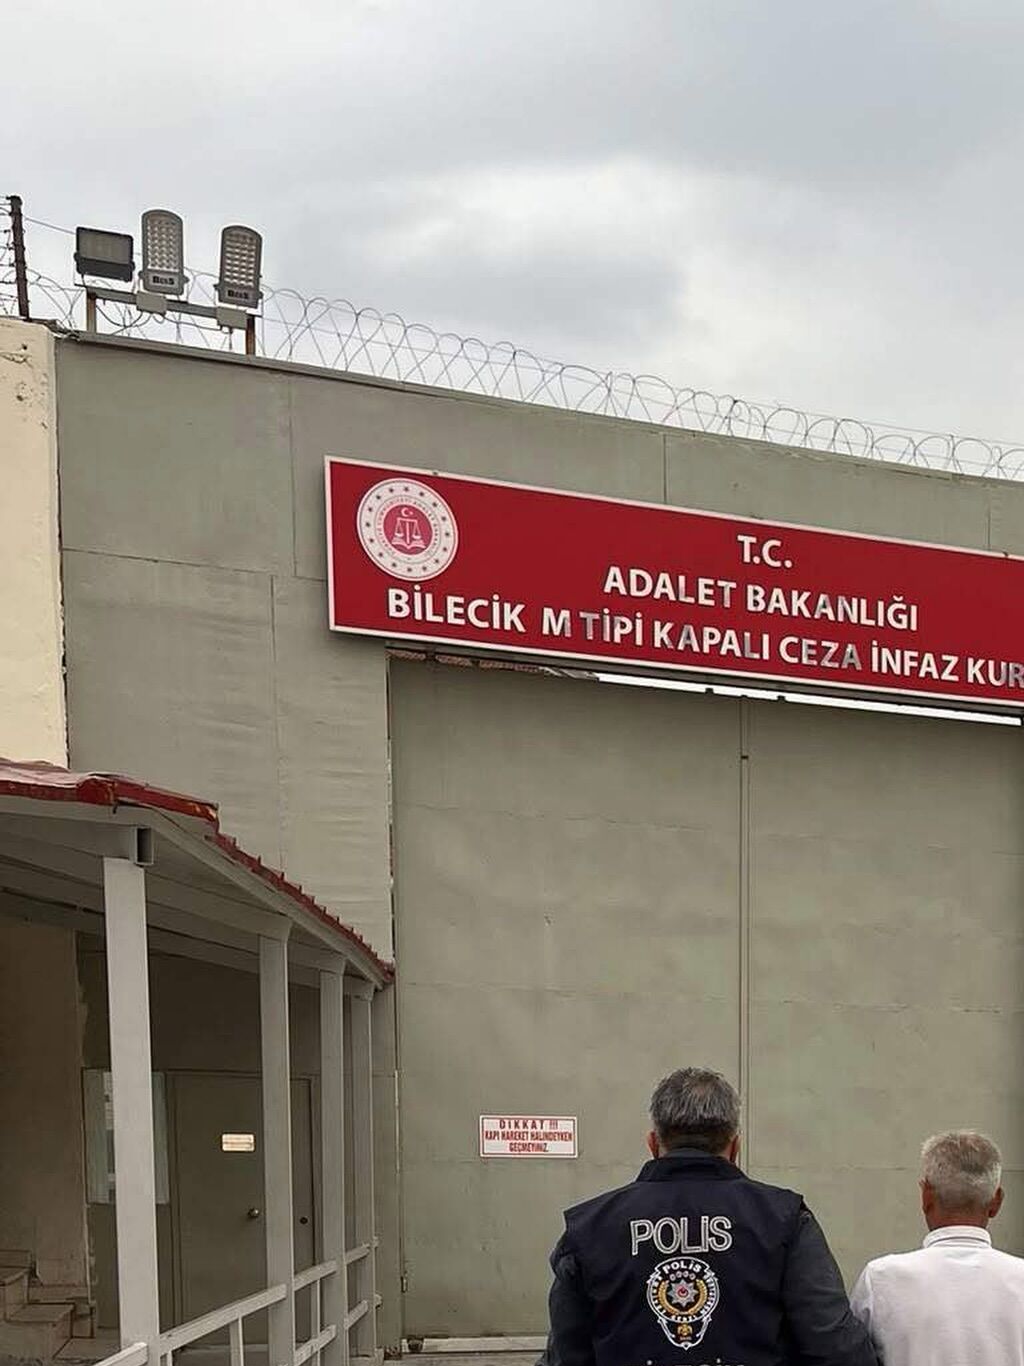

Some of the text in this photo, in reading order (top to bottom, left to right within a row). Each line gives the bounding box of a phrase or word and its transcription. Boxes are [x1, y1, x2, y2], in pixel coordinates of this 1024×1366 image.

[737, 534, 793, 568] T.C.
[603, 566, 918, 631] ADALET BAKANLIĞI
[388, 585, 526, 632] BİLECİK
[542, 607, 572, 637] M
[579, 608, 643, 646] TİPİ
[653, 620, 770, 661] KAPALI
[779, 636, 862, 670] CEZA
[872, 640, 960, 682] İNFAZ
